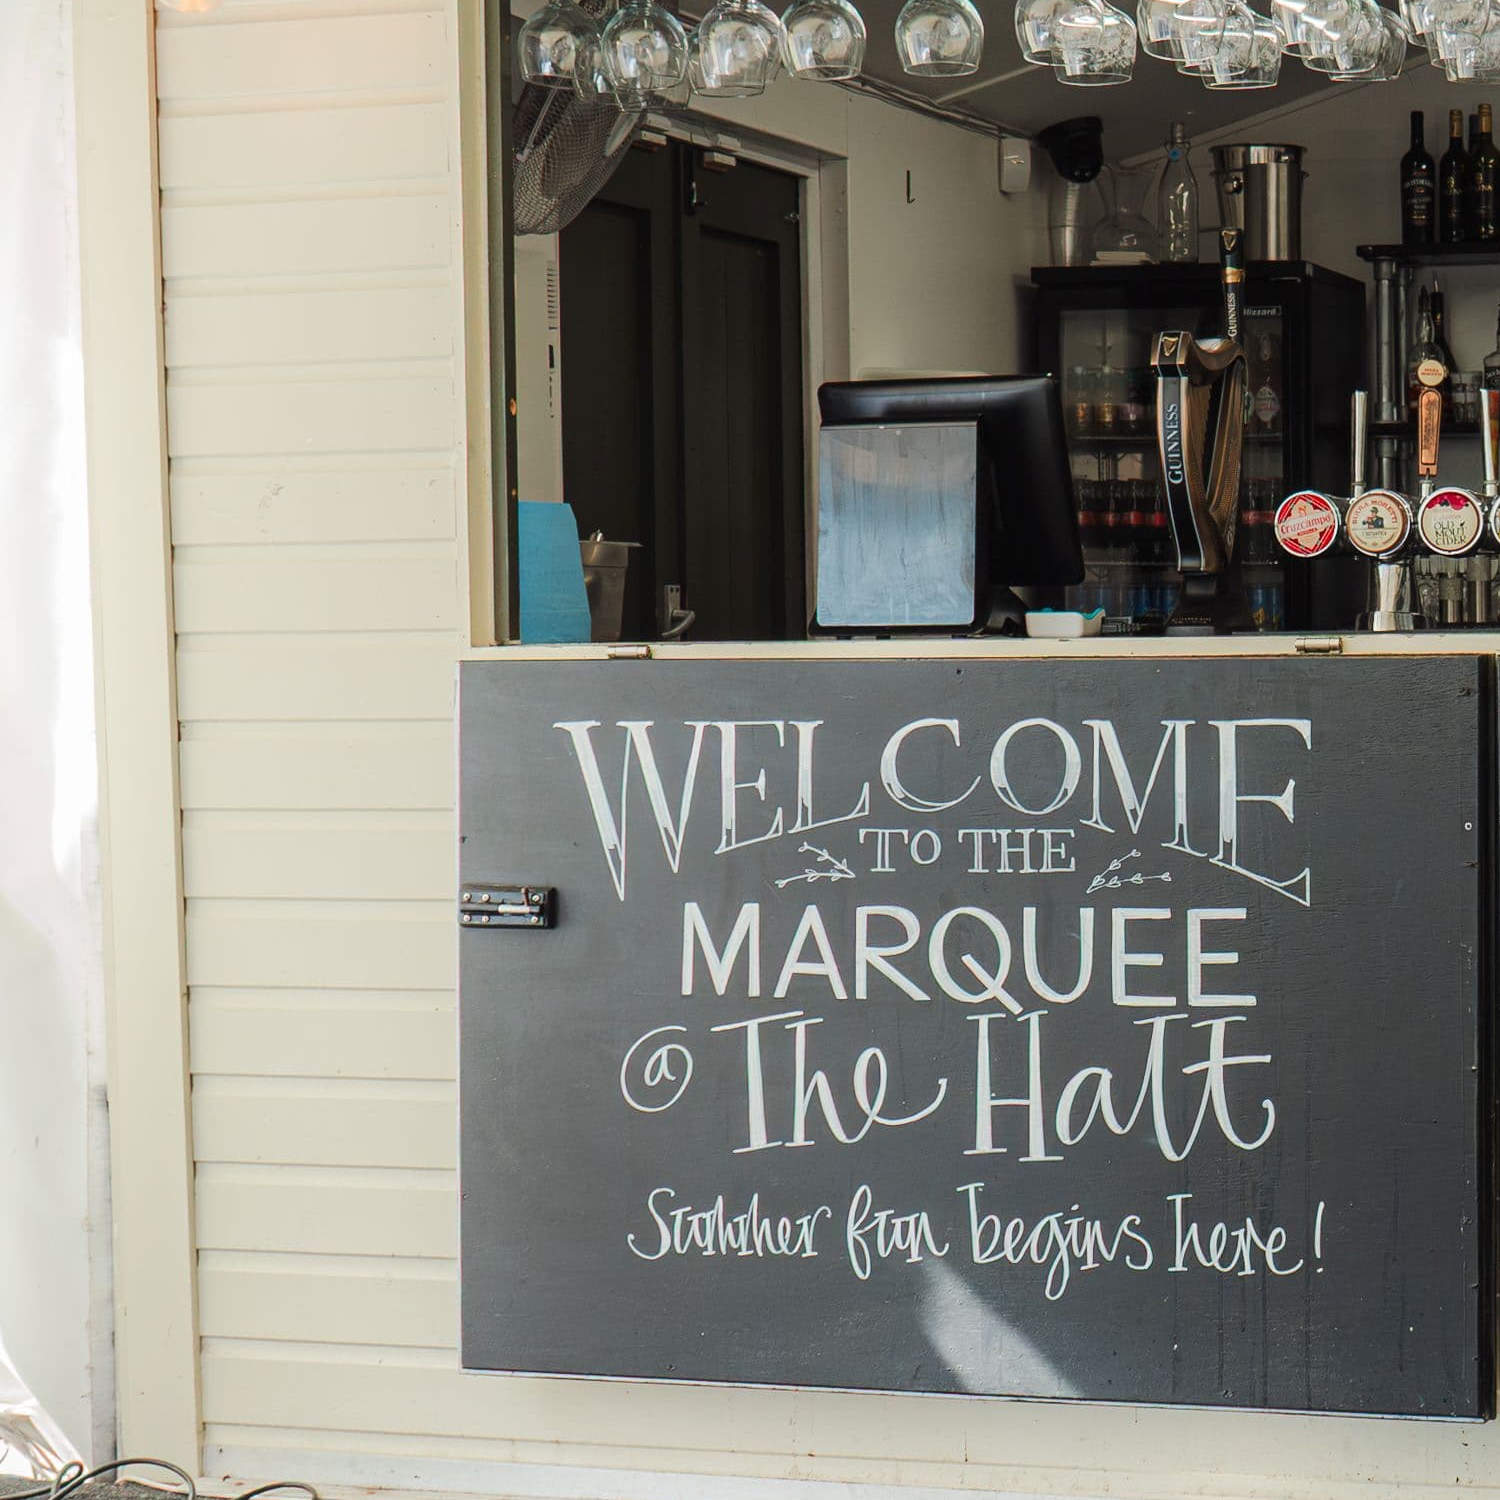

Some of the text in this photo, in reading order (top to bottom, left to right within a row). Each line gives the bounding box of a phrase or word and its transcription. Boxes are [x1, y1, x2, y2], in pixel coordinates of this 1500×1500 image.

[1227, 292, 1238, 338] GUINNESS
[1166, 403, 1184, 485] GUINNESS
[1280, 514, 1332, 535] Cruzcampo
[1433, 521, 1455, 531] OLD
[552, 718, 1312, 905] WELCOME
[858, 828, 1076, 874] TO THE
[681, 902, 1257, 1014] MARQUEE
[620, 1009, 1275, 1162] @ The Halt
[847, 1185, 949, 1280] fun
[957, 1183, 1153, 1300] begins
